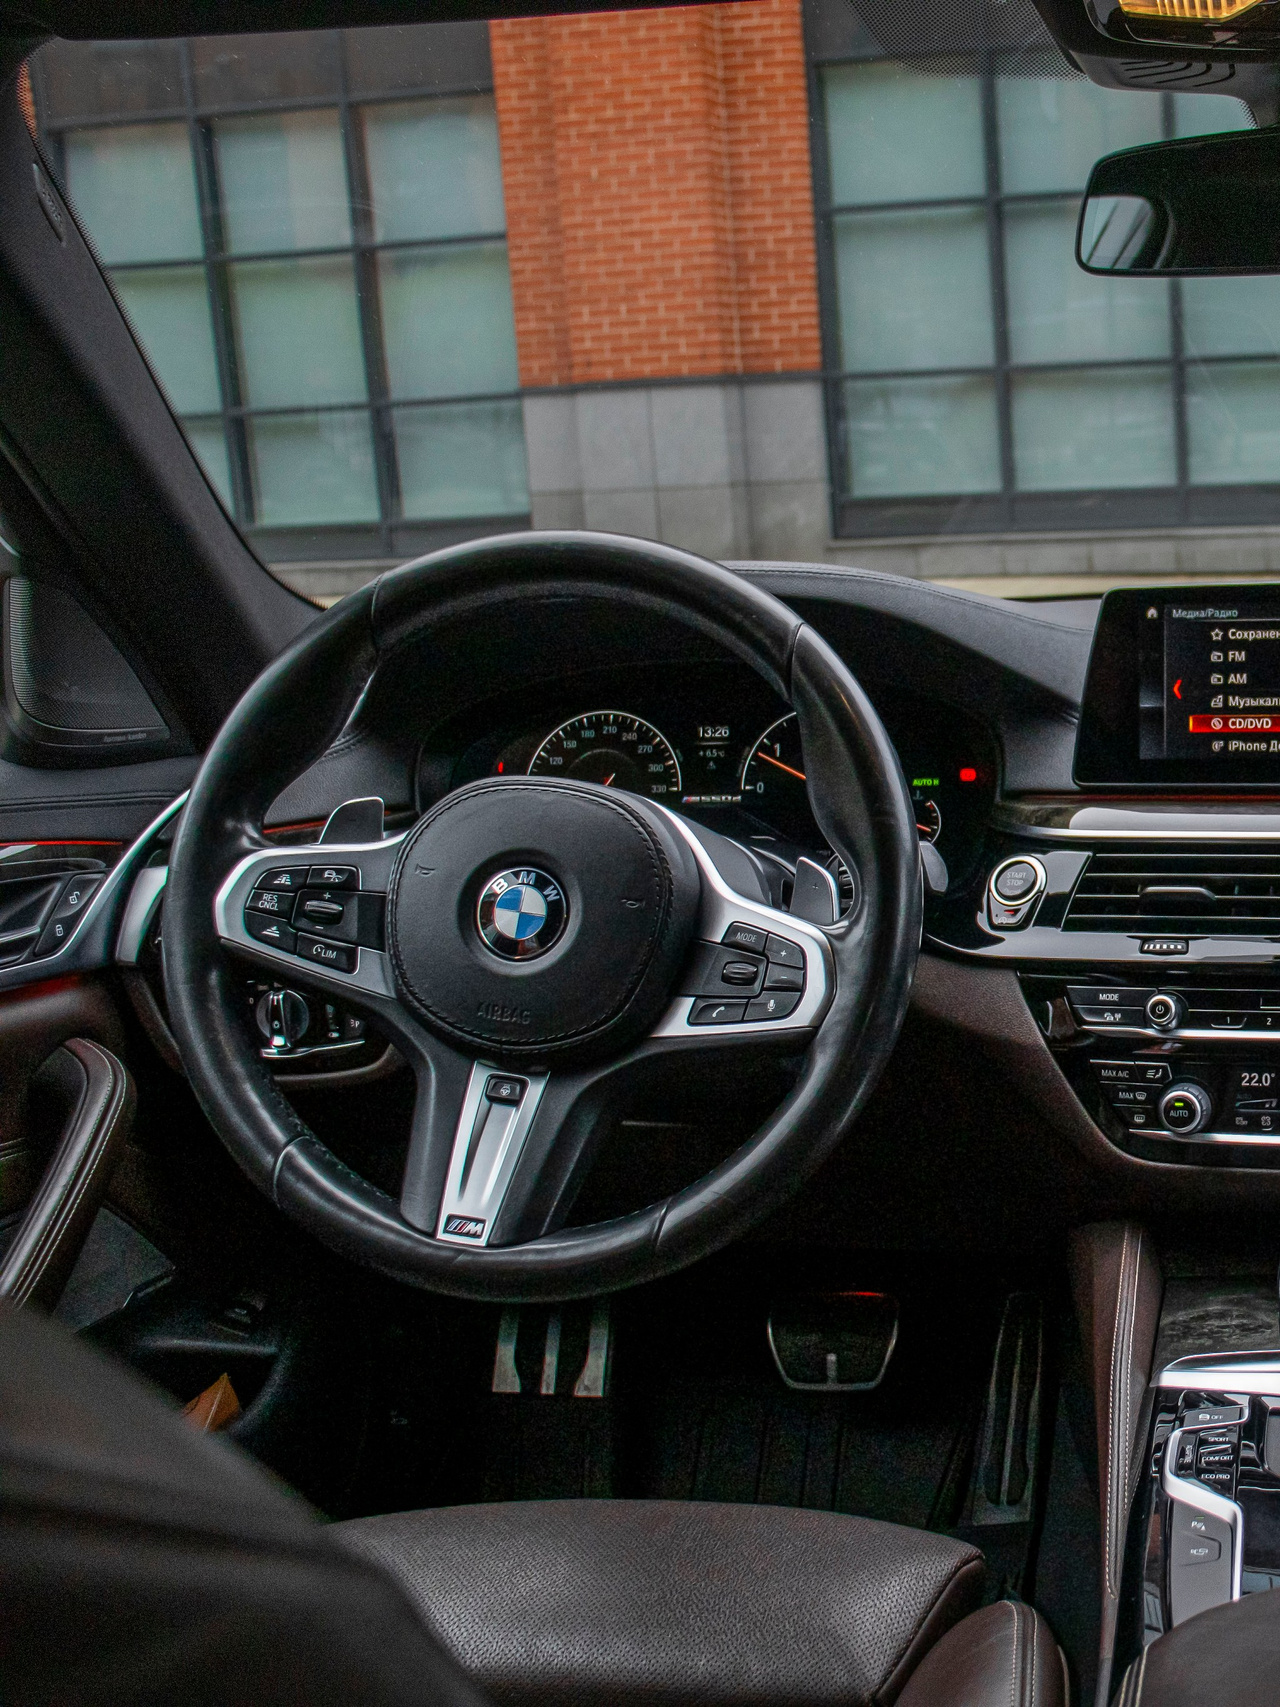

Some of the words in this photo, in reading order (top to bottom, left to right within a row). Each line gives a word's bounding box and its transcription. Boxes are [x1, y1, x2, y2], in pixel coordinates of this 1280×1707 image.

[1173, 609, 1238, 618] Медиа/Радио
[1228, 652, 1246, 662] FM
[1228, 674, 1247, 684] AM
[1228, 718, 1272, 729] CD/DVD
[581, 730, 594, 738] 180
[622, 732, 638, 740] 240
[698, 726, 730, 738] 13:26
[774, 744, 780, 757] 1
[1228, 740, 1267, 751] iPhone
[648, 764, 664, 772] 300
[652, 784, 666, 793] 330
[756, 782, 764, 794] 0
[492, 871, 560, 902] BMW
[262, 893, 278, 902] RES
[258, 900, 278, 910] CNCL
[735, 932, 758, 942] MODE
[321, 950, 337, 959] LIM
[478, 1002, 531, 1024] AIRBAG
[1241, 1072, 1276, 1086] 22.0°
